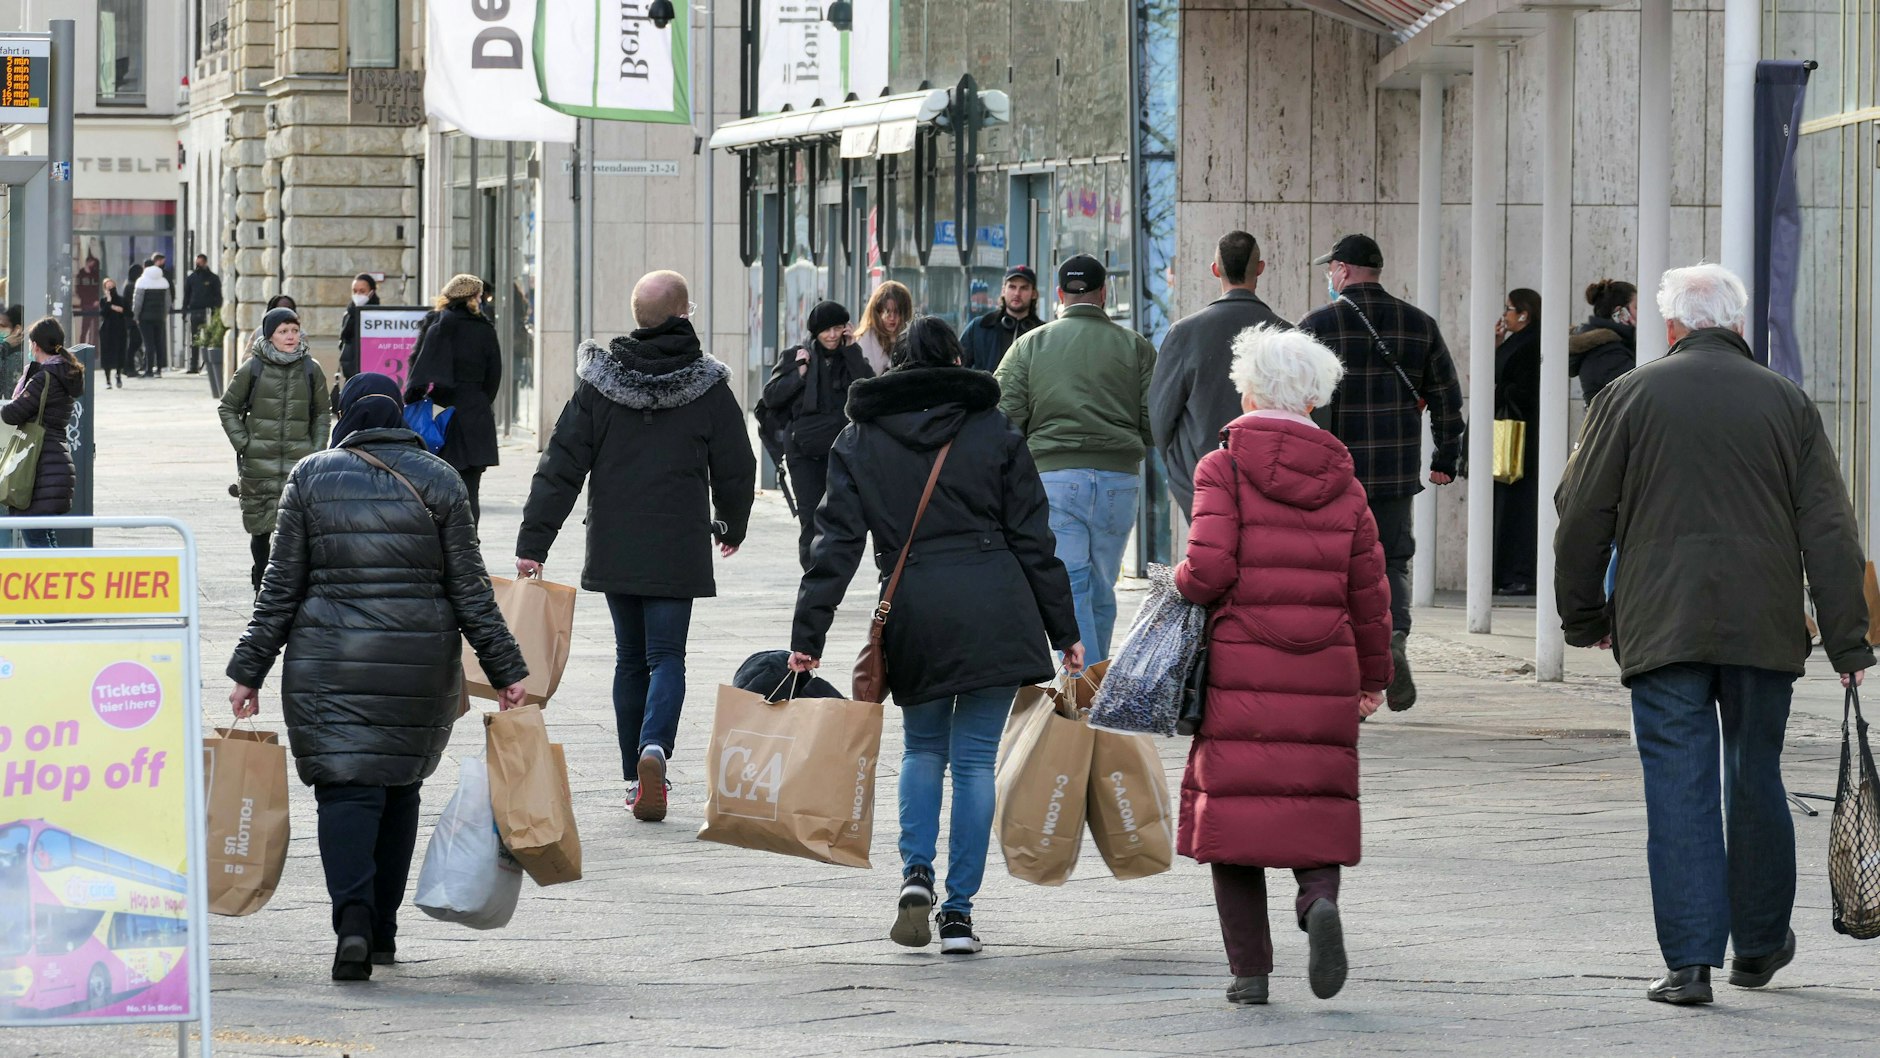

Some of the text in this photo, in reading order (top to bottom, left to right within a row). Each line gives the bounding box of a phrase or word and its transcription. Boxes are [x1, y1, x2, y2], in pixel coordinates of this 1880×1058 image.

[22, 47, 30, 55] in
[13, 57, 30, 66] min
[13, 65, 30, 74] min
[13, 73, 30, 82] min
[13, 81, 30, 90] min
[351, 70, 419, 88] URBAN
[13, 89, 30, 98] min
[13, 97, 30, 106] min
[352, 87, 421, 106] OUTFIT
[375, 105, 421, 124] TERS
[77, 157, 172, 172] TESLA
[650, 163, 676, 173] 21-24
[104, 571, 170, 599] HIER
[96, 682, 156, 700] Tickets
[25, 719, 80, 751] on
[3, 747, 167, 802] Hop off
[718, 746, 783, 803] C&A
[852, 756, 867, 820] C-A.COM
[1042, 774, 1069, 835] C-A.COM
[1110, 771, 1137, 832] C-A.COM
[236, 798, 253, 857] FOLLOW
[224, 836, 237, 856] US
[157, 1003, 182, 1012] Berlin
